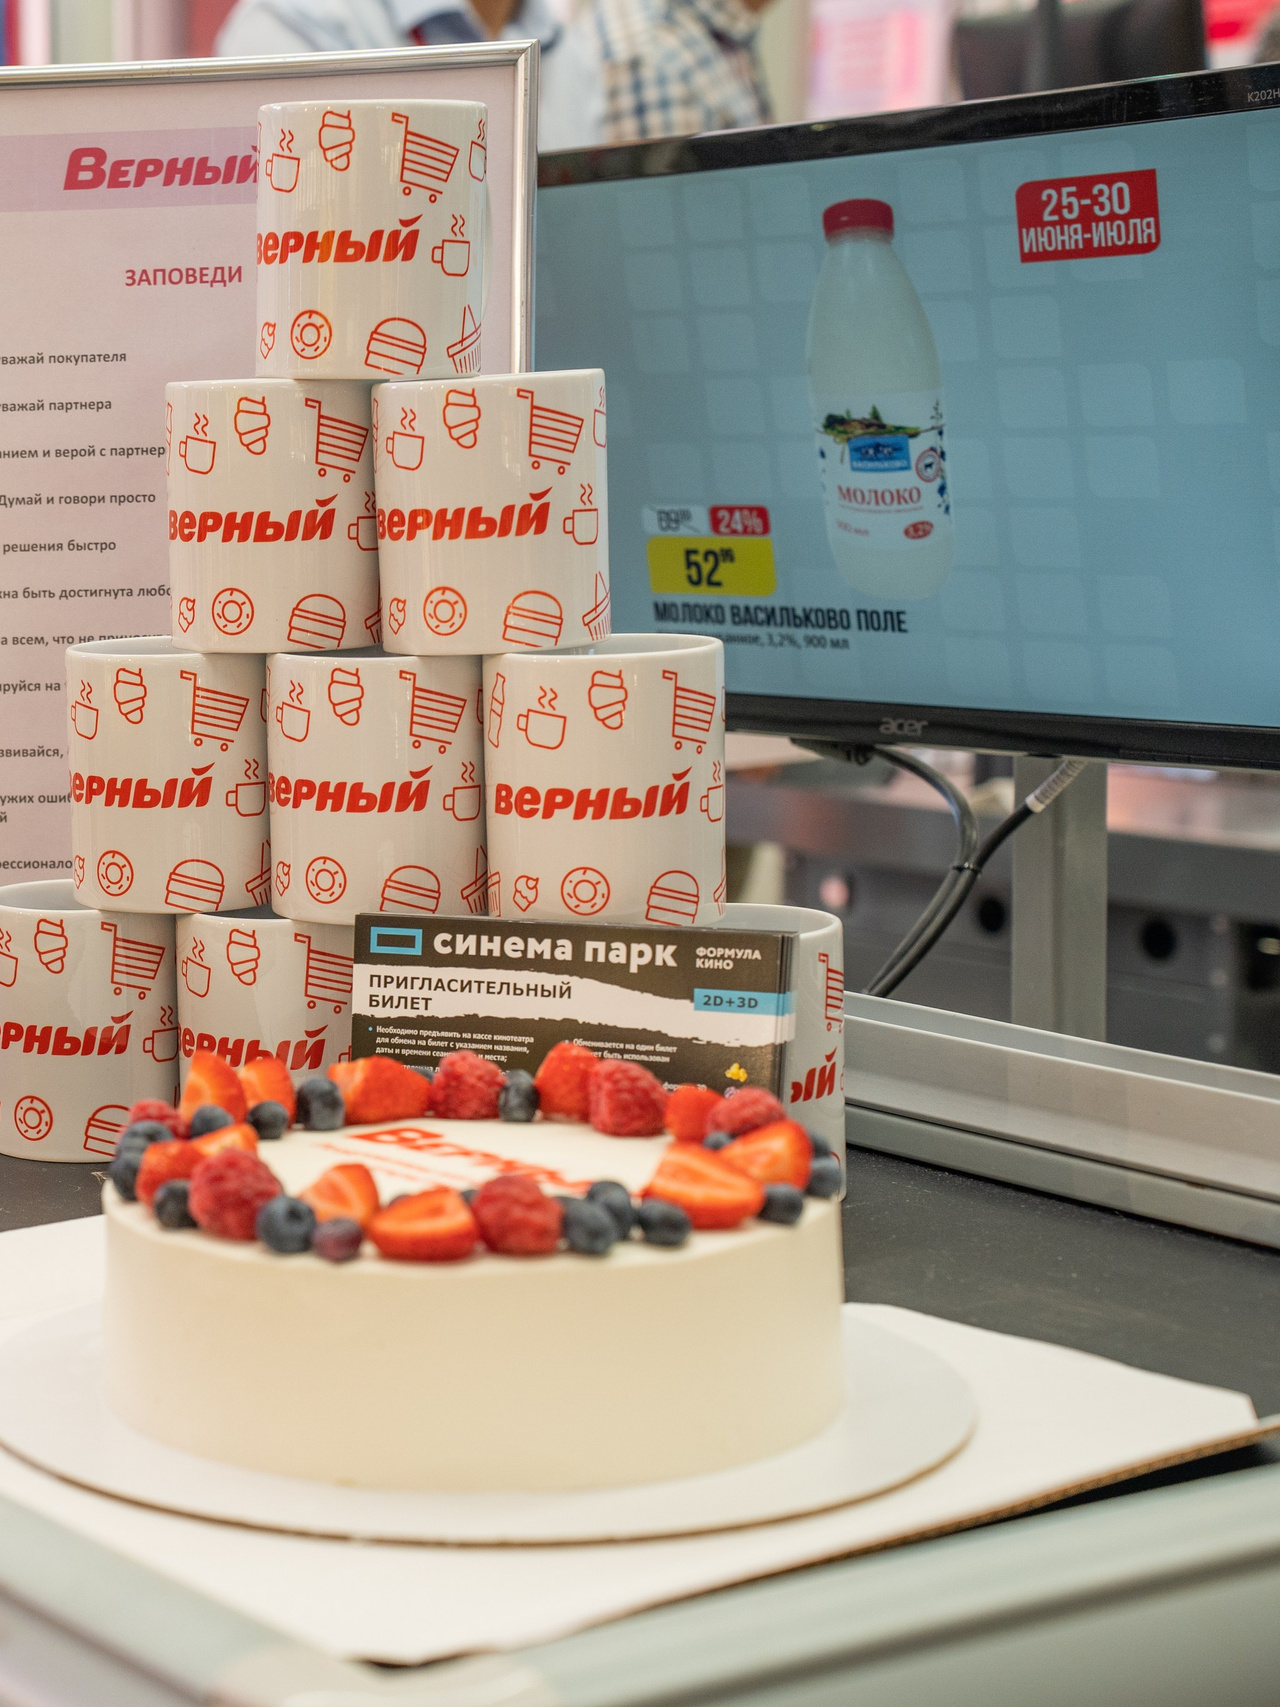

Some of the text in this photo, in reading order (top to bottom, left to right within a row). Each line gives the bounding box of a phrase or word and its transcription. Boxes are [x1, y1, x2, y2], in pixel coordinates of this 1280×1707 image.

[1041, 181, 1130, 222] 25-30
[1022, 217, 1156, 253] ИЮНЯ-ИЮЛЯ
[125, 265, 243, 287] ЗАПОВЕДИ
[48, 352, 127, 368] покупателя
[49, 399, 112, 414] партнера
[43, 448, 51, 458] и
[55, 444, 96, 459] верой
[99, 446, 106, 457] с
[110, 444, 166, 461] партнер
[47, 495, 55, 505] и
[59, 494, 105, 508] говори
[109, 493, 156, 507] просто
[838, 484, 921, 506] МОЛОКО
[717, 509, 763, 533] 24%
[3, 541, 63, 554] решения
[67, 540, 116, 553] быстро
[23, 587, 56, 600] быть
[59, 586, 133, 600] достигнута
[654, 602, 908, 633] МОЛОКО ВАСИЛЬКОВО ПОЛЕ
[12, 635, 49, 647] всем,
[52, 634, 75, 645] что
[79, 634, 95, 644] не
[830, 637, 849, 650] мл
[45, 681, 60, 692] на
[880, 718, 928, 736] acer
[434, 932, 677, 973] синема парк
[696, 946, 762, 961] ФОРМУЛА
[696, 958, 733, 971] КИНО
[369, 974, 572, 999] ПРИГЛАСИТЕЛЬНЫЙ
[369, 994, 432, 1011] БИЛЕТ
[703, 994, 758, 1009] 2D+3D
[376, 1026, 418, 1036] Необходимо
[419, 1029, 461, 1039] предъявить
[473, 1033, 492, 1041] кассе
[494, 1035, 534, 1043] кинотеатра
[376, 1036, 389, 1044] для
[391, 1037, 416, 1045] обмена
[428, 1038, 448, 1047] билет
[456, 1042, 492, 1051] указанием
[494, 1044, 530, 1053] названия,
[376, 1046, 393, 1055] даты
[402, 1048, 431, 1057] времени
[573, 1038, 624, 1050] Обменивается
[636, 1043, 654, 1052] один
[656, 1044, 677, 1053] билет
[603, 1051, 622, 1059] быть
[623, 1053, 670, 1062] использован
